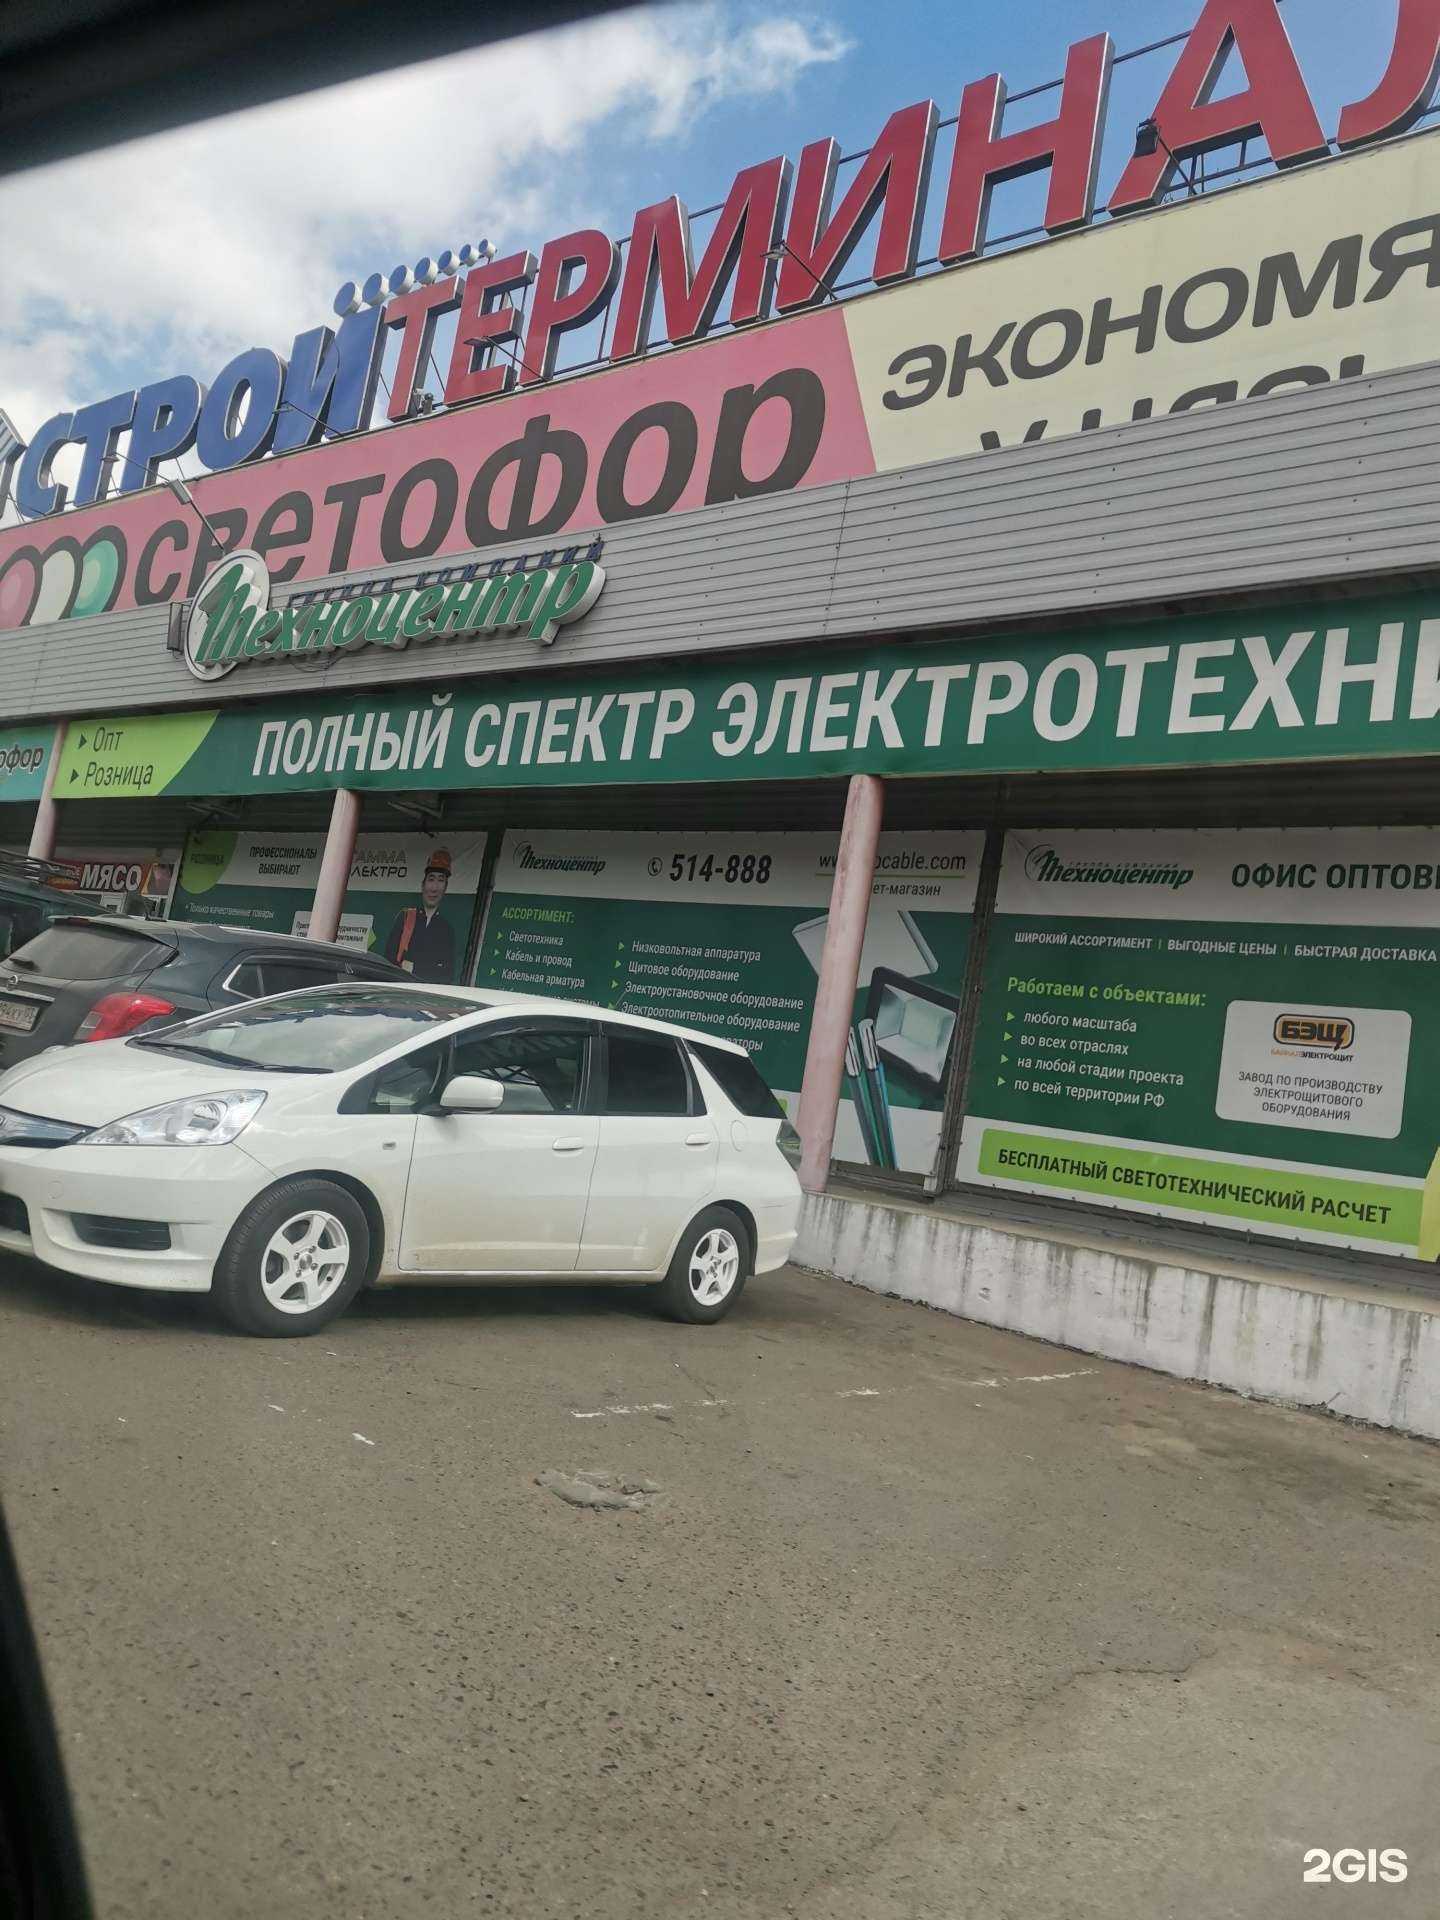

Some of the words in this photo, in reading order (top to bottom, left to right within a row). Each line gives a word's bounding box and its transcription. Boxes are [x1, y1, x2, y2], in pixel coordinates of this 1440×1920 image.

[881, 213, 1440, 412] ЭКОНОМЯ
[93, 727, 124, 753] Опт
[252, 694, 454, 777] ПОЛНЫЙ
[464, 688, 697, 769] СПЕКТР
[84, 761, 154, 790] Розница
[249, 846, 318, 860] ПРОФЕССИОНАЛЫ
[80, 863, 142, 892] МЯСО
[258, 863, 301, 875] ВЫБИРАЮТ
[350, 866, 408, 878] ЛЕКТРО
[669, 853, 773, 884] 514-888
[1231, 862, 1317, 889] ОФИС
[1326, 863, 1440, 890] ОПТОВ
[873, 883, 941, 896] ет-магазин
[502, 906, 575, 924] АССОРТИМЕНТ:
[509, 930, 563, 946] Светотехника
[1014, 930, 1068, 945] ШИРОКИЙ
[1069, 934, 1153, 950] АССОРТИМЕНТ
[1167, 938, 1236, 955] ВЫГОДНЫЕ
[1239, 942, 1277, 956] ЦЕНЫ
[505, 949, 534, 964] Кабель
[535, 954, 541, 963] и
[542, 955, 573, 969] провод
[632, 941, 702, 958] Низковольтная
[704, 947, 761, 964] аппаратура
[1294, 944, 1357, 959] БЫСТРАЯ
[1359, 947, 1437, 962] ДОСТАВКА
[501, 968, 544, 983] Кабельная
[545, 975, 585, 989] арматура
[628, 961, 670, 975] Щитовое
[671, 965, 740, 982] оборудование
[624, 981, 728, 1002] Электроустановочное
[730, 991, 804, 1010] оборудование
[1007, 976, 1085, 998] Работаем
[1089, 985, 1098, 998] с
[1102, 983, 1207, 1007] объектами:
[621, 1002, 724, 1025] Электроотопительное
[726, 1013, 801, 1032] оборудование
[1023, 1011, 1069, 1026] любого
[1072, 1016, 1137, 1033] масштаба
[1020, 1034, 1035, 1046] во
[1038, 1037, 1067, 1049] всех
[1069, 1039, 1129, 1055] отраслях
[1017, 1057, 1032, 1069] на
[1034, 1058, 1076, 1073] любой
[1079, 1064, 1125, 1080] стадии
[1128, 1068, 1184, 1086] проекта
[1014, 1078, 1029, 1091] по
[1032, 1081, 1062, 1095] всей
[1065, 1084, 1140, 1105] территории
[1143, 1092, 1165, 1107] РФ
[1238, 1071, 1273, 1086] ЗАВОД
[1276, 1075, 1291, 1086] ПО
[1294, 1077, 1383, 1095] ПРОИЗВОДСТВУ
[1253, 1086, 1363, 1108] ЭЛЕКТРОЩИТОВОГО
[1262, 1101, 1351, 1121] ОБОРУДОВАНИЯ
[998, 1147, 1108, 1181] БЕСПЛАТНЫЙ
[1112, 1166, 1306, 1212] СВЕТОТЕХНИЧЕСКИЙ
[1310, 1196, 1393, 1226] РАСЧЕТ
